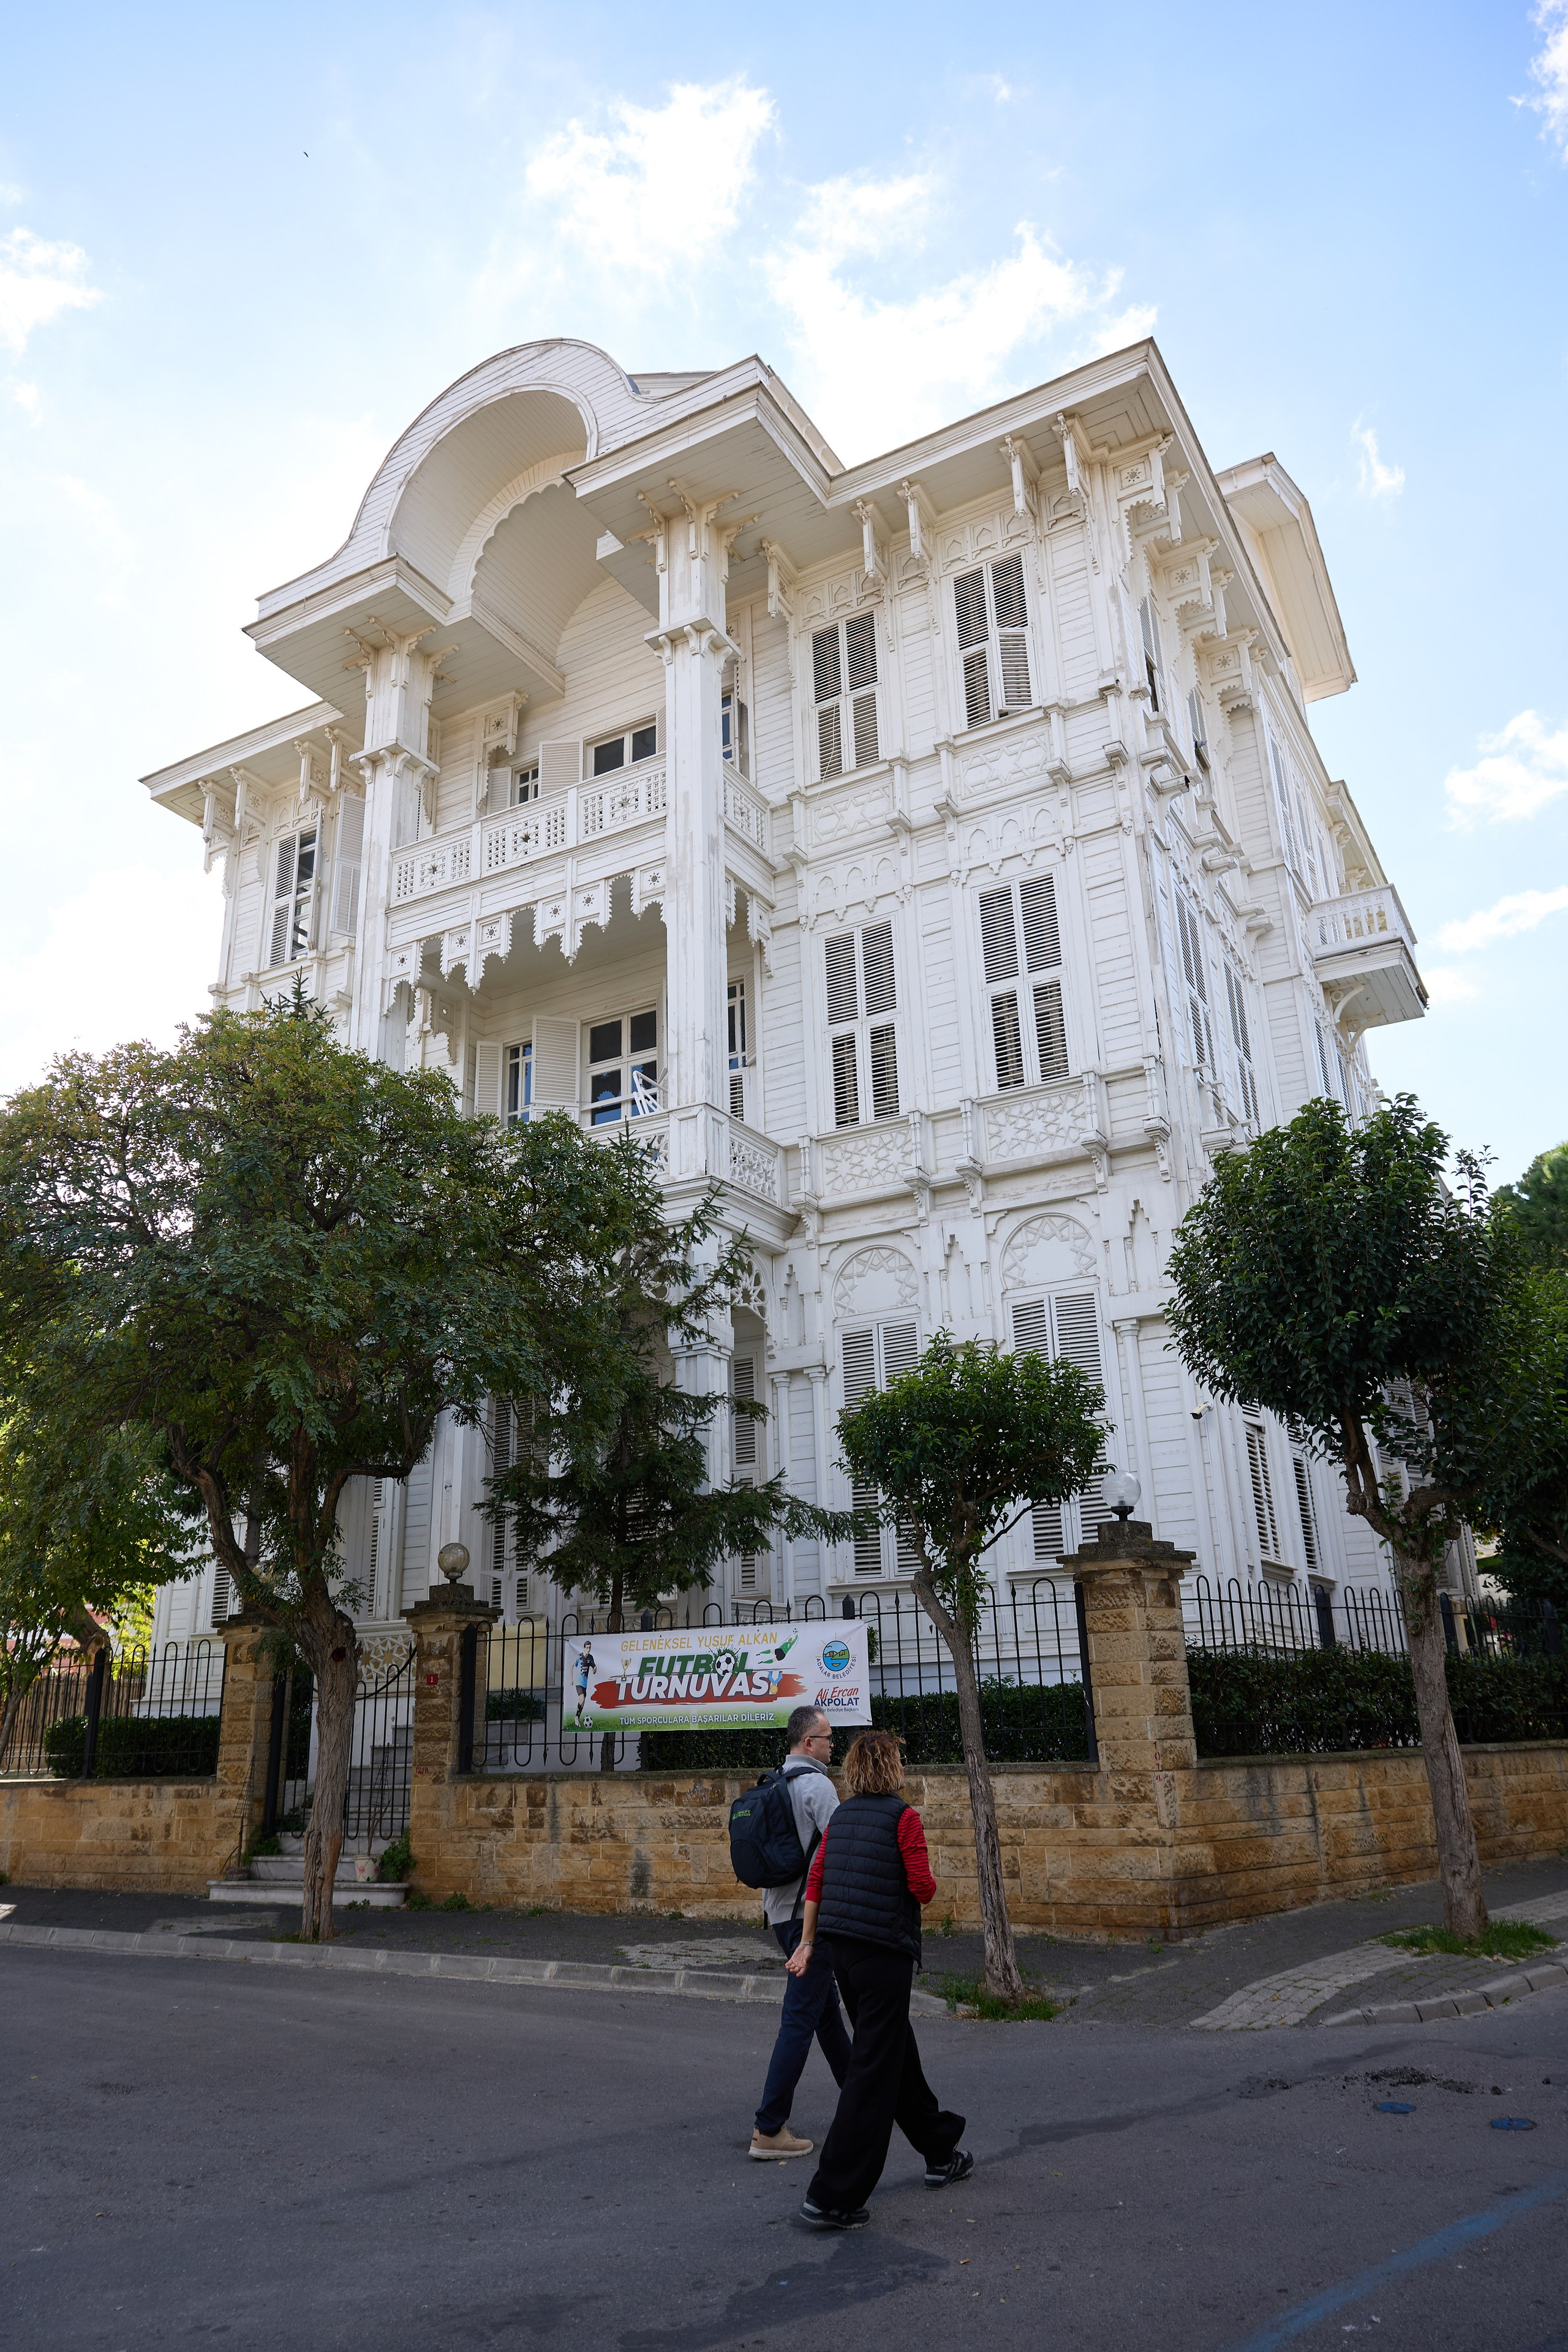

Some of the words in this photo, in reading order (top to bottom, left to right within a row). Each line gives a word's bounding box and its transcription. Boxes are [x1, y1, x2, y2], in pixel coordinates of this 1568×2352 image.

[620, 1637, 692, 1652] GELENEKSEL
[698, 1635, 735, 1648] YUSUF
[738, 1632, 778, 1646] ALKAN
[816, 1658, 831, 1678] ADALAR
[832, 1656, 857, 1679] BELEDİYESİ
[816, 1688, 829, 1700] Ali
[831, 1686, 859, 1698] Ercan
[814, 1697, 859, 1706] AKPOLAT
[620, 1716, 635, 1725] TÜM
[637, 1716, 689, 1724] SPORCULARA
[692, 1714, 739, 1724] BAŞARILAR
[741, 1711, 774, 1722] DİLERİZ
